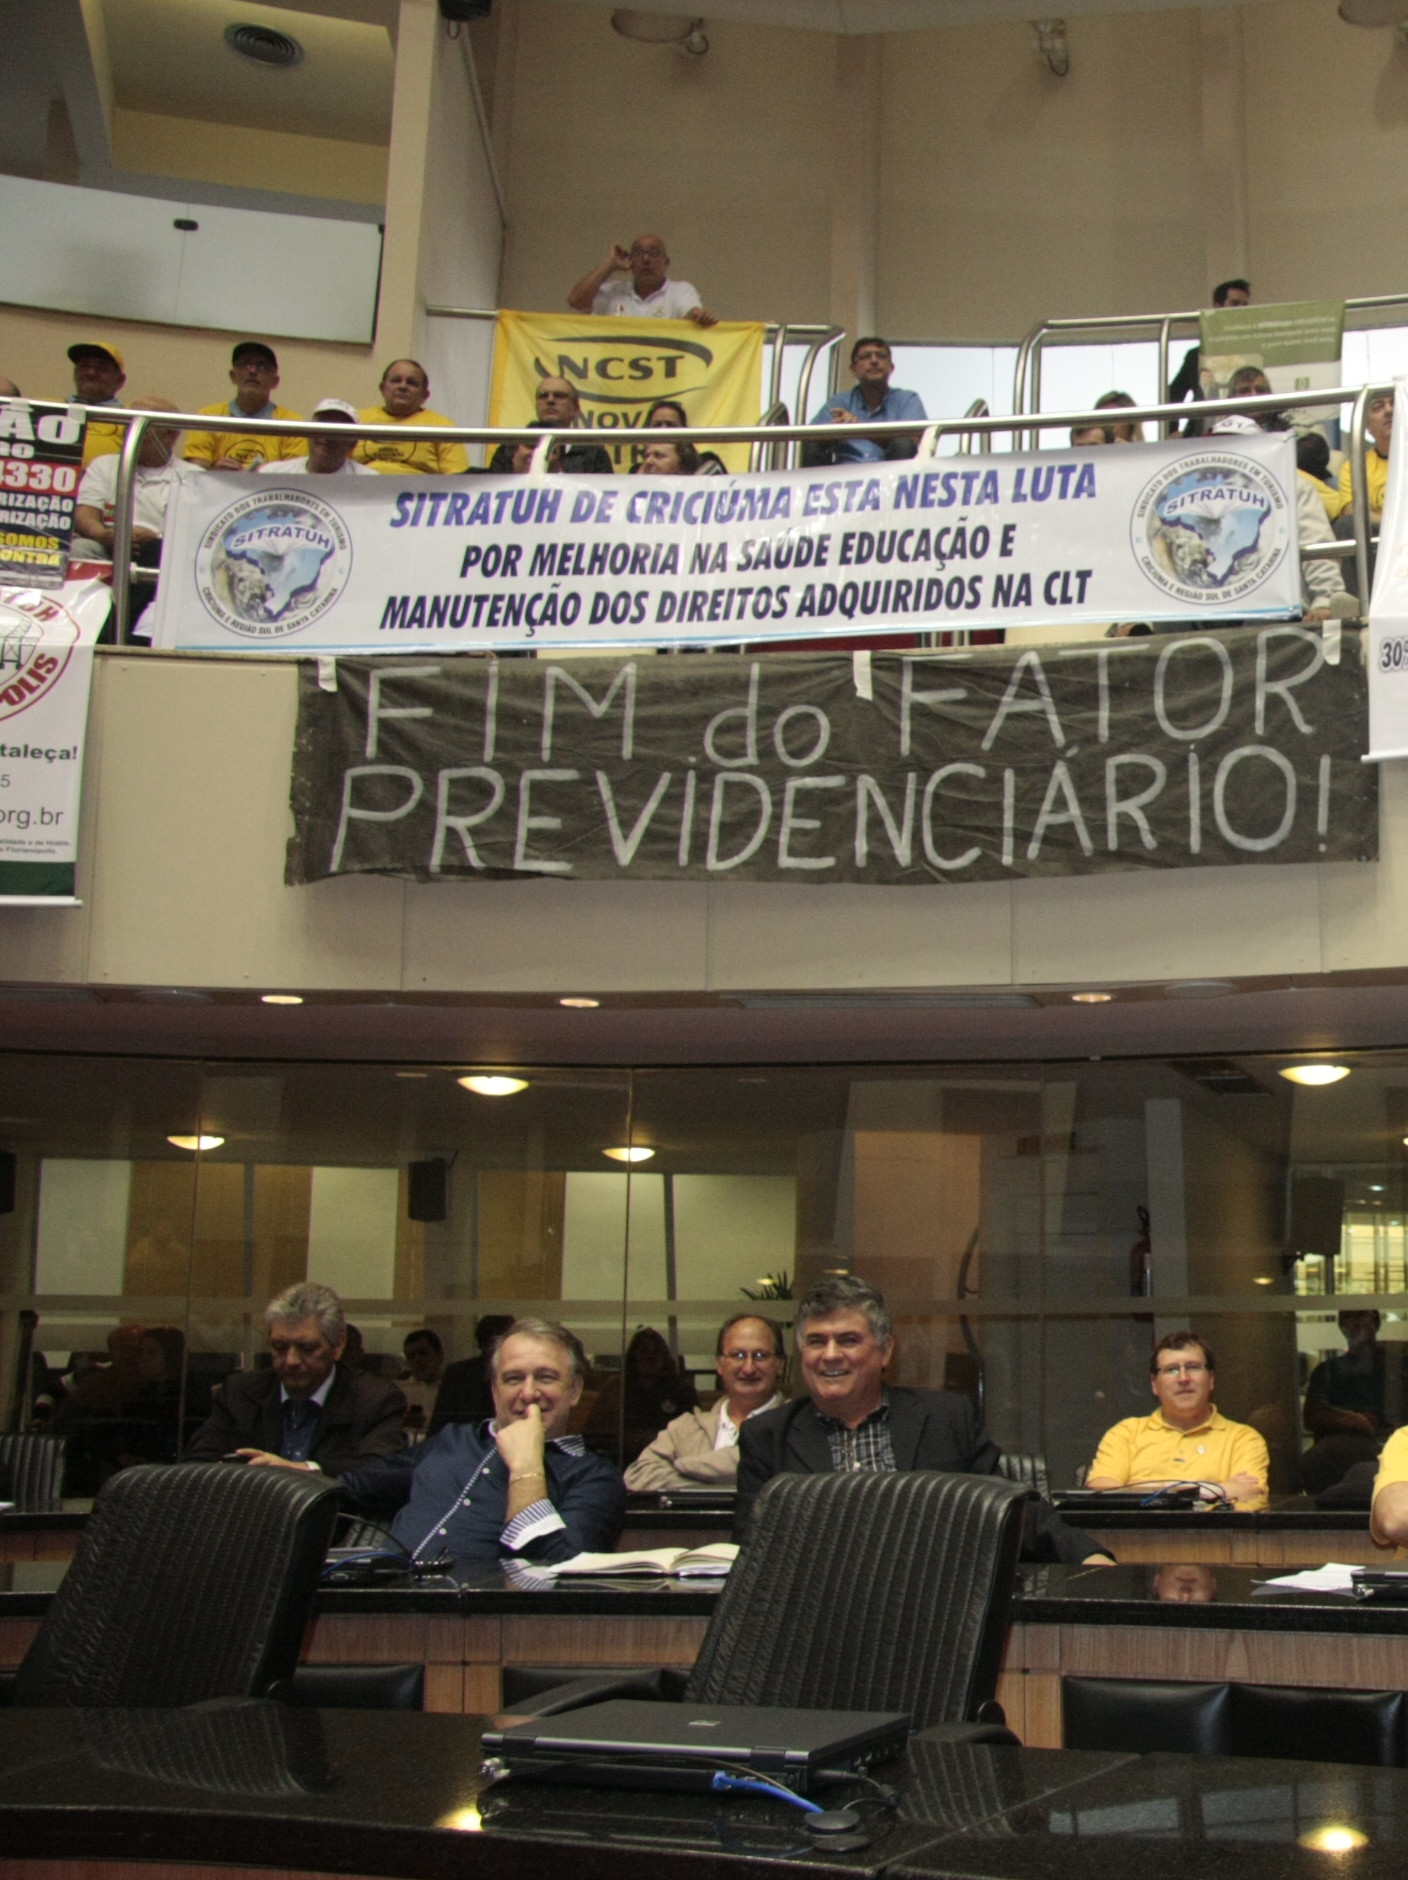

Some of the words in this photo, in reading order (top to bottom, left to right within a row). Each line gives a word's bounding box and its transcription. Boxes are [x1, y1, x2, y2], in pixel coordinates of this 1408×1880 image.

[558, 354, 685, 381] NCST
[389, 488, 563, 528] SITRATUH
[569, 490, 619, 523] DE
[625, 479, 791, 526] CRICIÚMA
[801, 477, 881, 517] ESTA
[893, 470, 999, 510] NESTA
[1011, 463, 1097, 503] LUTA
[1166, 487, 1266, 515] SITRATUH
[233, 526, 331, 549] SITRATUH
[460, 544, 523, 578] POR
[528, 541, 680, 577] MELHORIA
[688, 541, 728, 576] NA
[736, 527, 832, 572] SAÚDE
[839, 515, 990, 571] EDUCAÇÃO
[999, 524, 1016, 557] E
[379, 582, 581, 637] MANUTENÇÃO
[588, 590, 650, 625] DOS
[655, 584, 790, 624] DIREITOS
[796, 574, 983, 620] ADQUIRIDOS
[991, 573, 1033, 608] NA
[1043, 569, 1093, 605] CLT
[0, 653, 59, 706] OLIS
[366, 662, 637, 763] FIM
[704, 662, 830, 769] do
[901, 627, 1326, 757] FATOR
